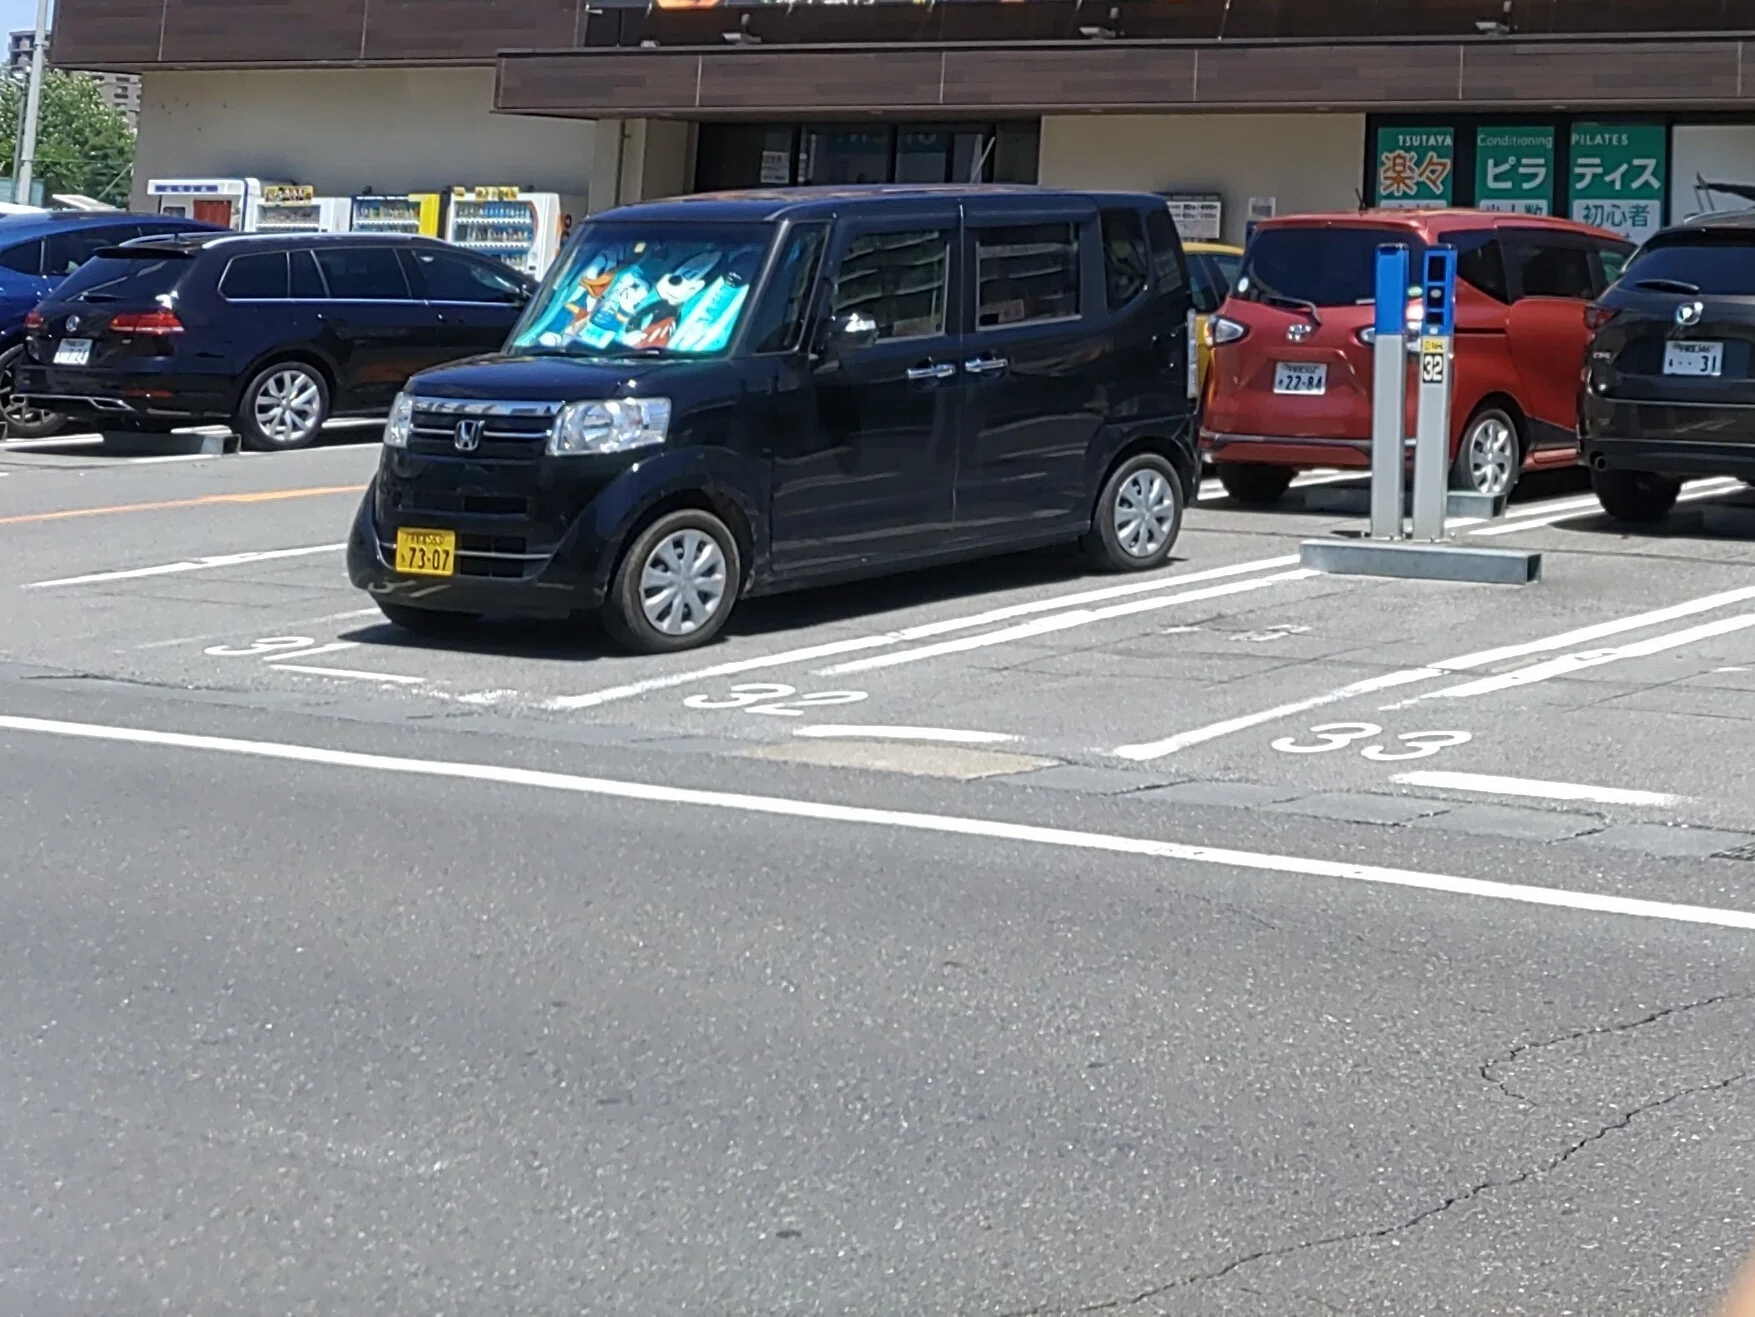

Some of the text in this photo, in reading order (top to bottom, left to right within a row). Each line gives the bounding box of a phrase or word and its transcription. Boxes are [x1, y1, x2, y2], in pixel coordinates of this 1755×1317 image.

[1399, 133, 1629, 149] TSUTAYA Conditioning PILATES
[1379, 149, 1661, 196] 楽々 ピラ ティス
[1582, 204, 1650, 227] 初心者
[1423, 354, 1443, 381] 32
[409, 546, 450, 571] 73-07
[683, 682, 869, 716] 32
[1271, 722, 1473, 761] 33
